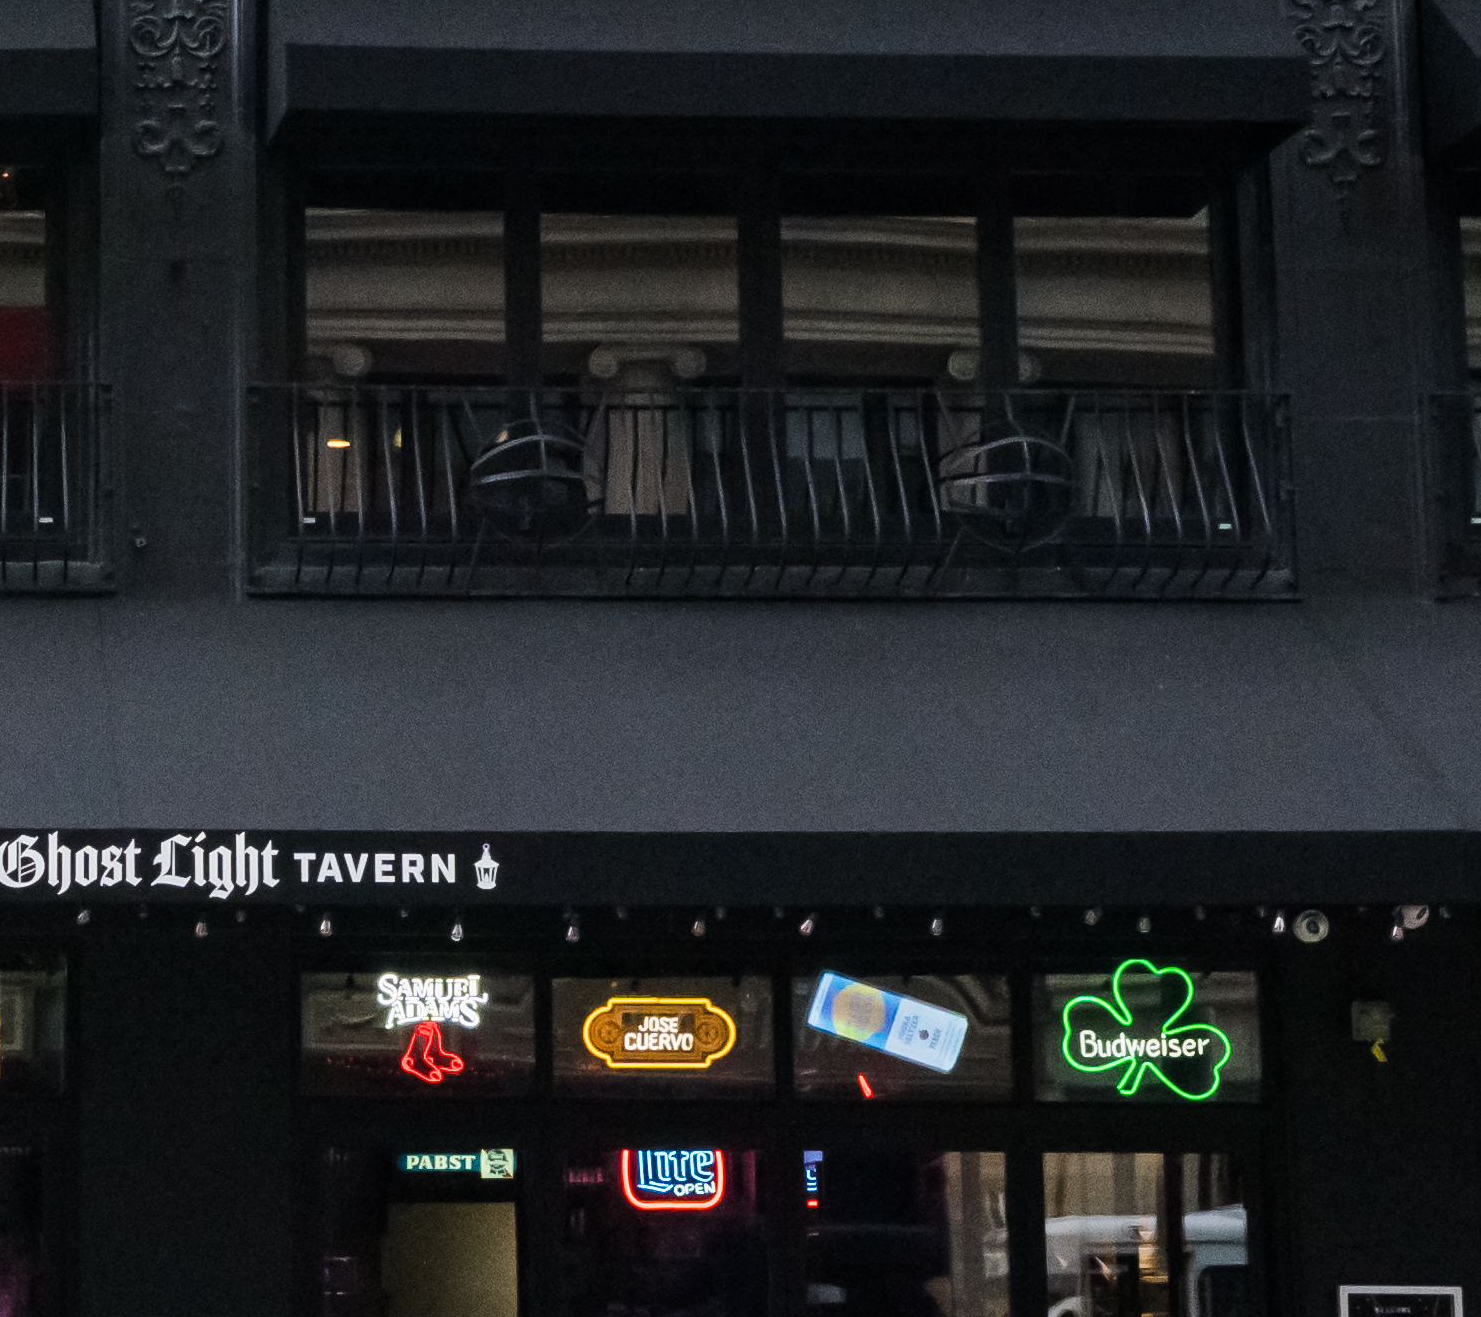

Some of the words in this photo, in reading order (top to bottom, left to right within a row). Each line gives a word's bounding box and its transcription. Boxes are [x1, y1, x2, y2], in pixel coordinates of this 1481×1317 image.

[151, 831, 280, 900] Light
[293, 852, 456, 884] TAVERN
[377, 973, 488, 1005] SAMUEL
[385, 998, 481, 1029] ADAMS
[638, 1016, 679, 1033] JOSE
[624, 1033, 693, 1051] CUERVO
[1079, 1030, 1210, 1058] Budweiser
[406, 1155, 476, 1171] PABST
[673, 1181, 716, 1197] OPEN
